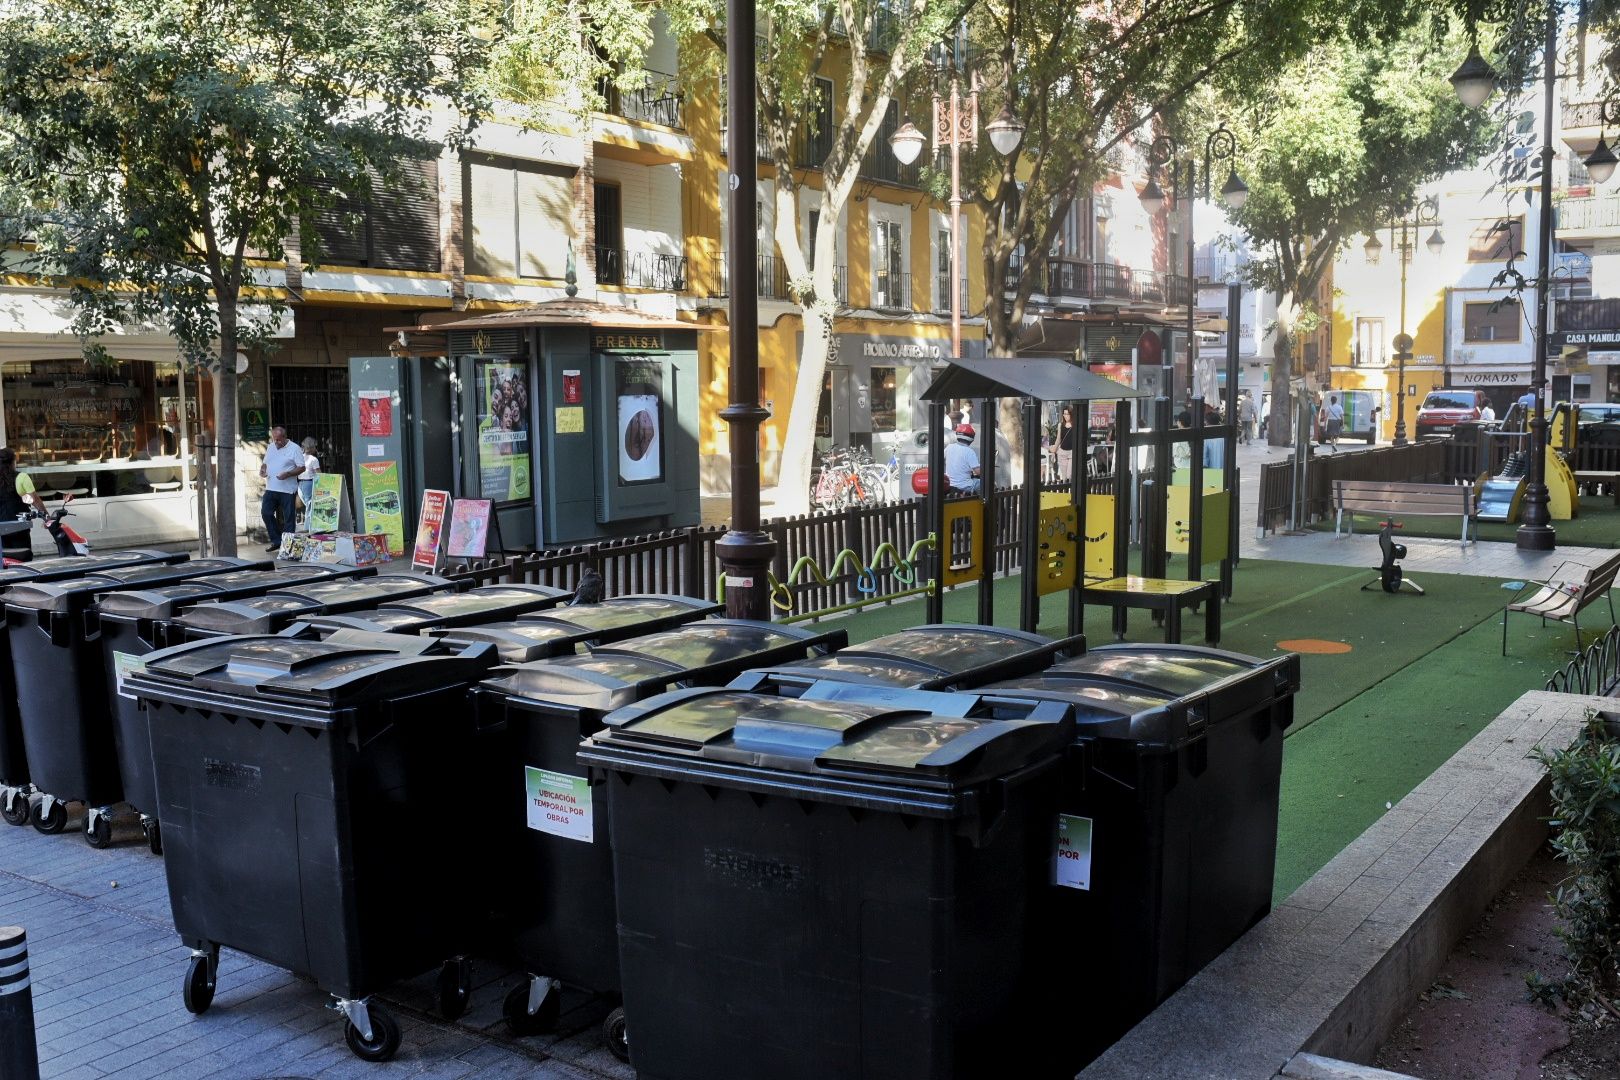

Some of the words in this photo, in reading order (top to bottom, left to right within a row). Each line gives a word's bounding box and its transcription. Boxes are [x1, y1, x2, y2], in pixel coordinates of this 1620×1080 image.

[728, 173, 740, 191] 9
[595, 335, 660, 349] PRENSA
[1566, 334, 1586, 344] CASA
[1588, 333, 1620, 343] MANOLO
[863, 342, 898, 358] HORNO
[1463, 373, 1519, 384] NOMADS
[533, 798, 568, 814] TEMPORAL
[569, 807, 584, 817] POR
[546, 813, 570, 825] OBRAS
[1059, 849, 1079, 861] POR
